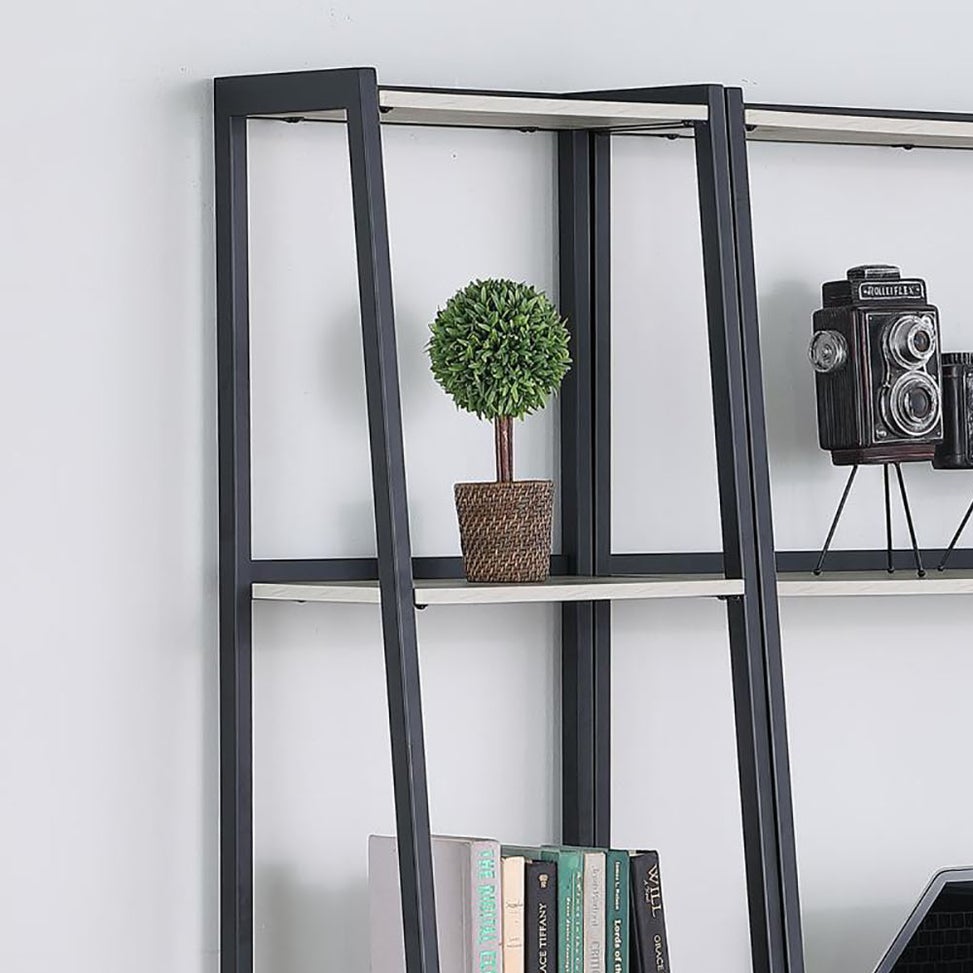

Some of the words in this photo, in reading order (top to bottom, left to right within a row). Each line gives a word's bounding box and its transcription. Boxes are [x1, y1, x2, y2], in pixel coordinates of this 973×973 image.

[479, 850, 494, 879] THE
[648, 865, 661, 917] WILL
[479, 885, 497, 944] DIGITAL
[539, 904, 547, 949] TIFFANY
[614, 951, 621, 961] of
[655, 935, 663, 970] GRACE
